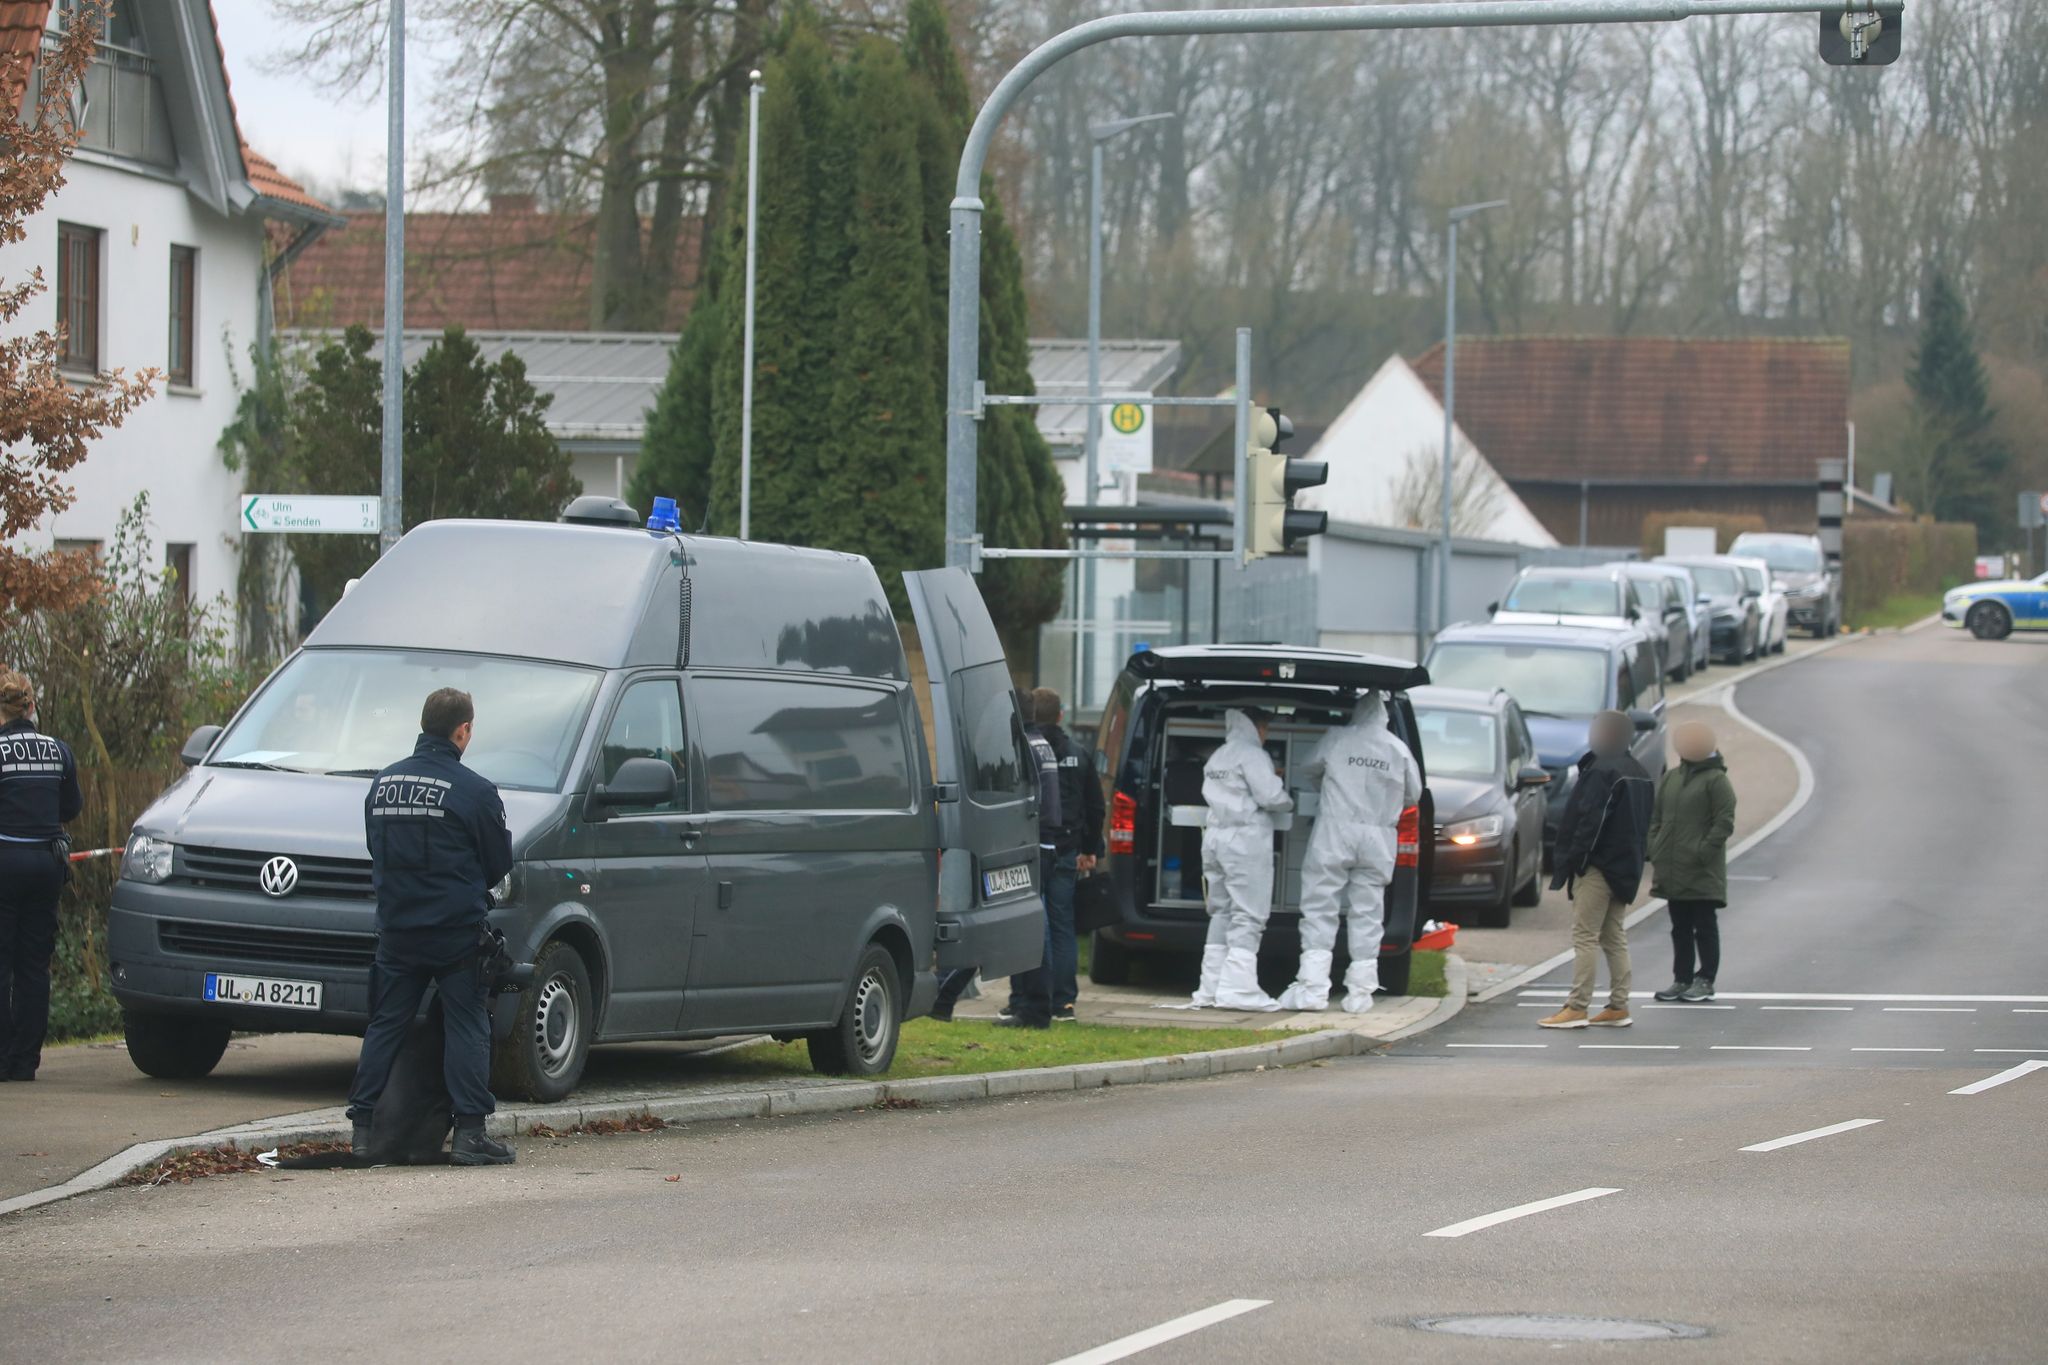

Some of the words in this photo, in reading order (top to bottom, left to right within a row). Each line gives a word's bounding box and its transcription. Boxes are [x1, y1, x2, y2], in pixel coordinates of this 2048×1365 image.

[272, 502, 292, 512] Ulm
[361, 503, 369, 513] 11
[284, 517, 321, 527] Senden
[0, 741, 63, 761] POLIZEI
[1347, 757, 1391, 772] POLIZEI
[375, 784, 445, 806] POLIZEI
[217, 978, 240, 1000] UL
[254, 981, 266, 1002] A
[270, 983, 317, 1006] 8211
